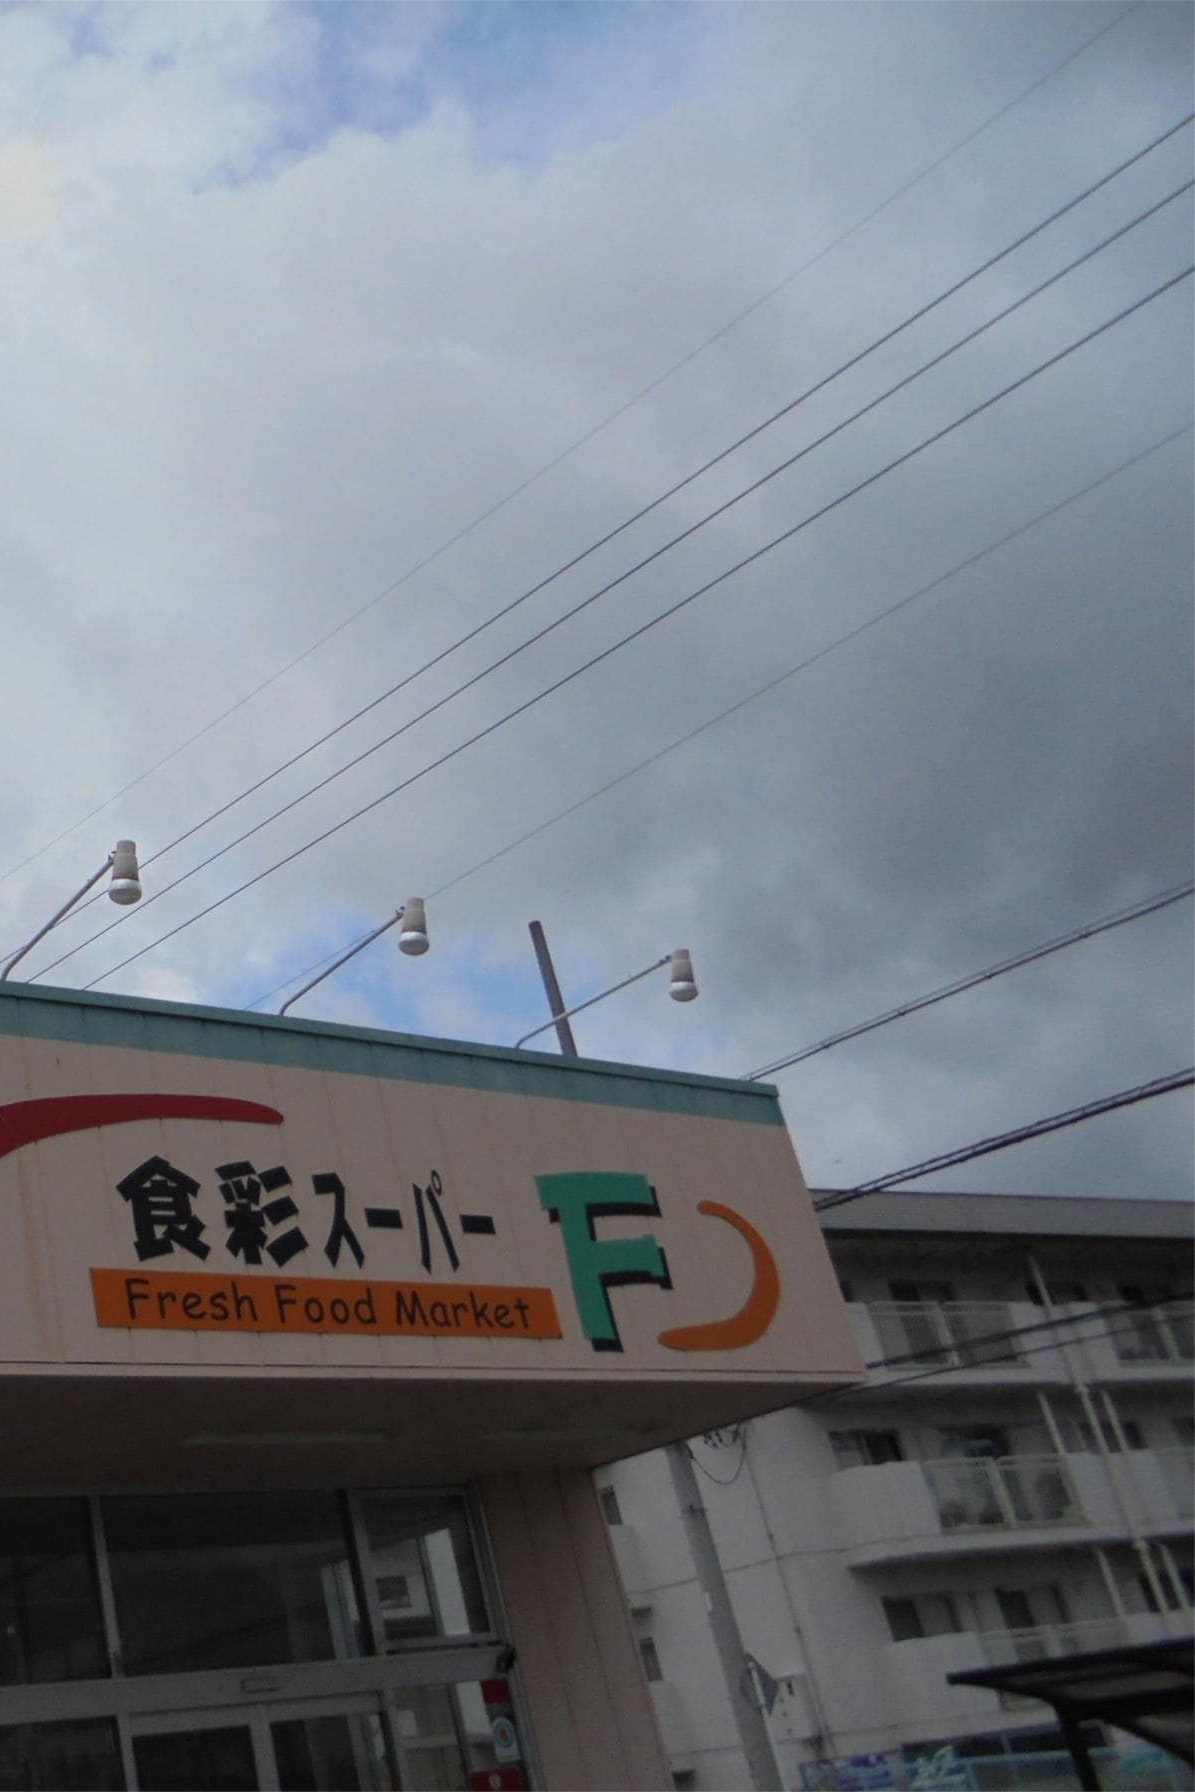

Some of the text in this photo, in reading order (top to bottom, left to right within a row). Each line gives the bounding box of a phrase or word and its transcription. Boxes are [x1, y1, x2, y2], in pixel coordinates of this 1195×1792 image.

[116, 1155, 497, 1274] 食彩スーパー
[124, 1277, 531, 1330] Fresh Food Market
